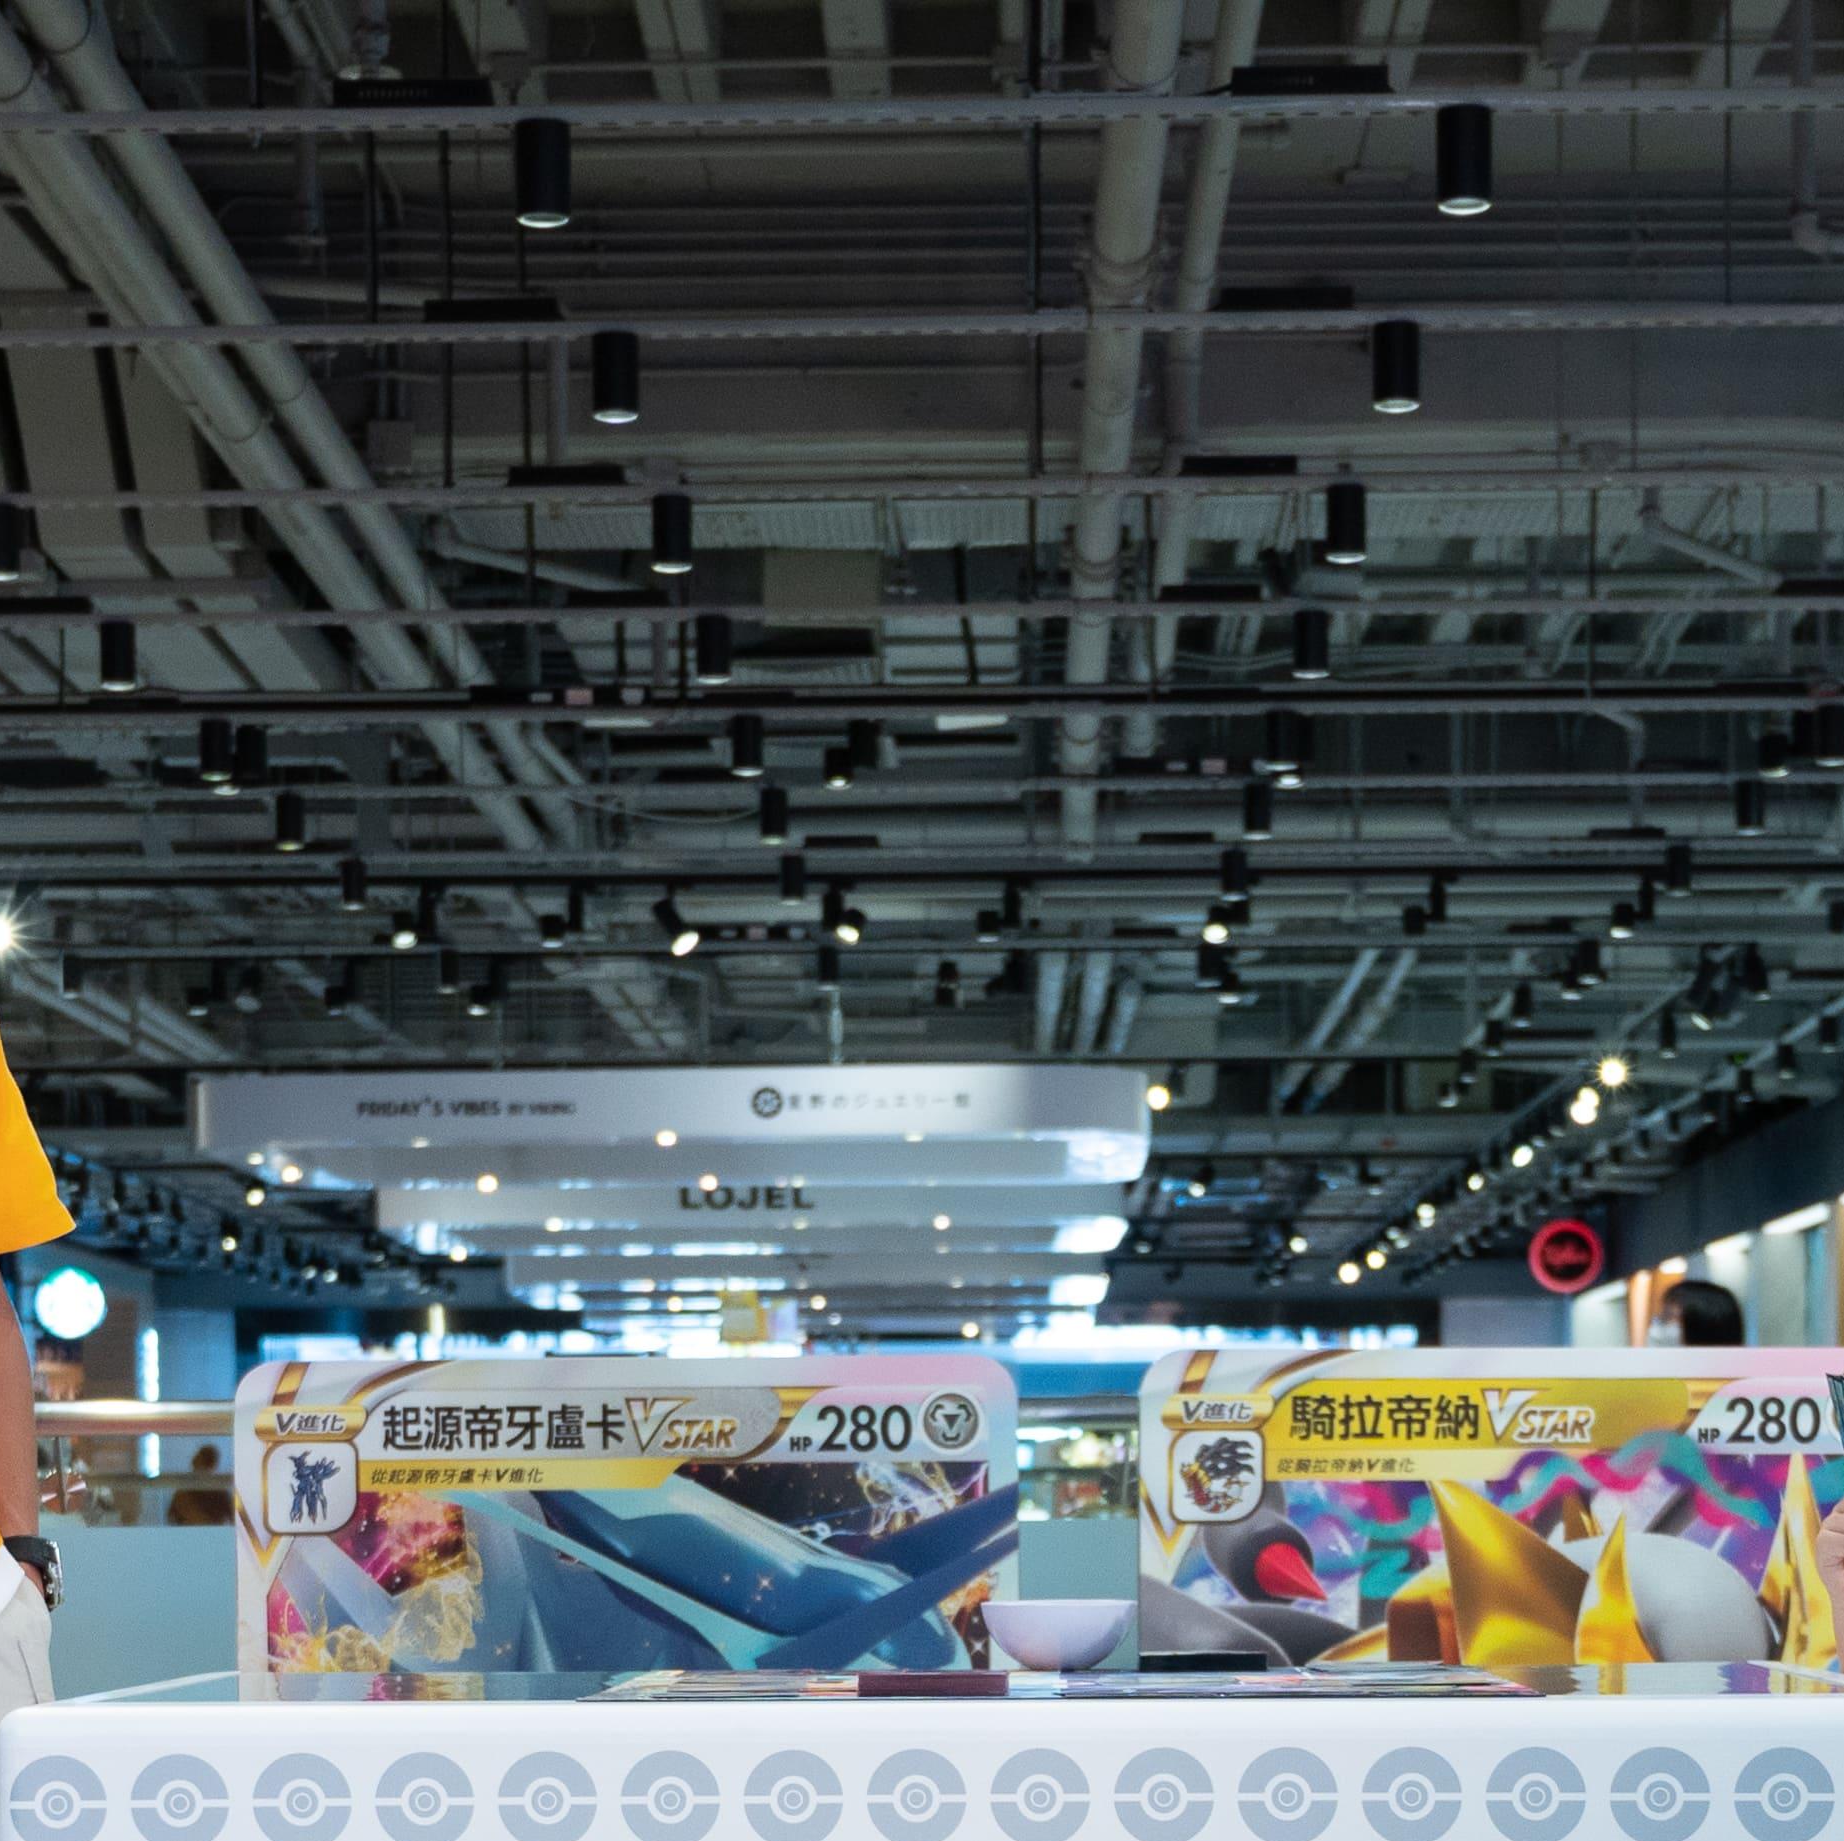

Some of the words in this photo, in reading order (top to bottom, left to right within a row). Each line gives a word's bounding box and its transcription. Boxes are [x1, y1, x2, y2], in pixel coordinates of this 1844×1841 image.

[678, 1185, 815, 1211] LOJEL
[790, 1436, 813, 1452] HP
[818, 1405, 912, 1452] 280
[1291, 1394, 1480, 1441] 騎拉帝納
[1698, 1427, 1720, 1443] HP
[1726, 1397, 1821, 1443] 280
